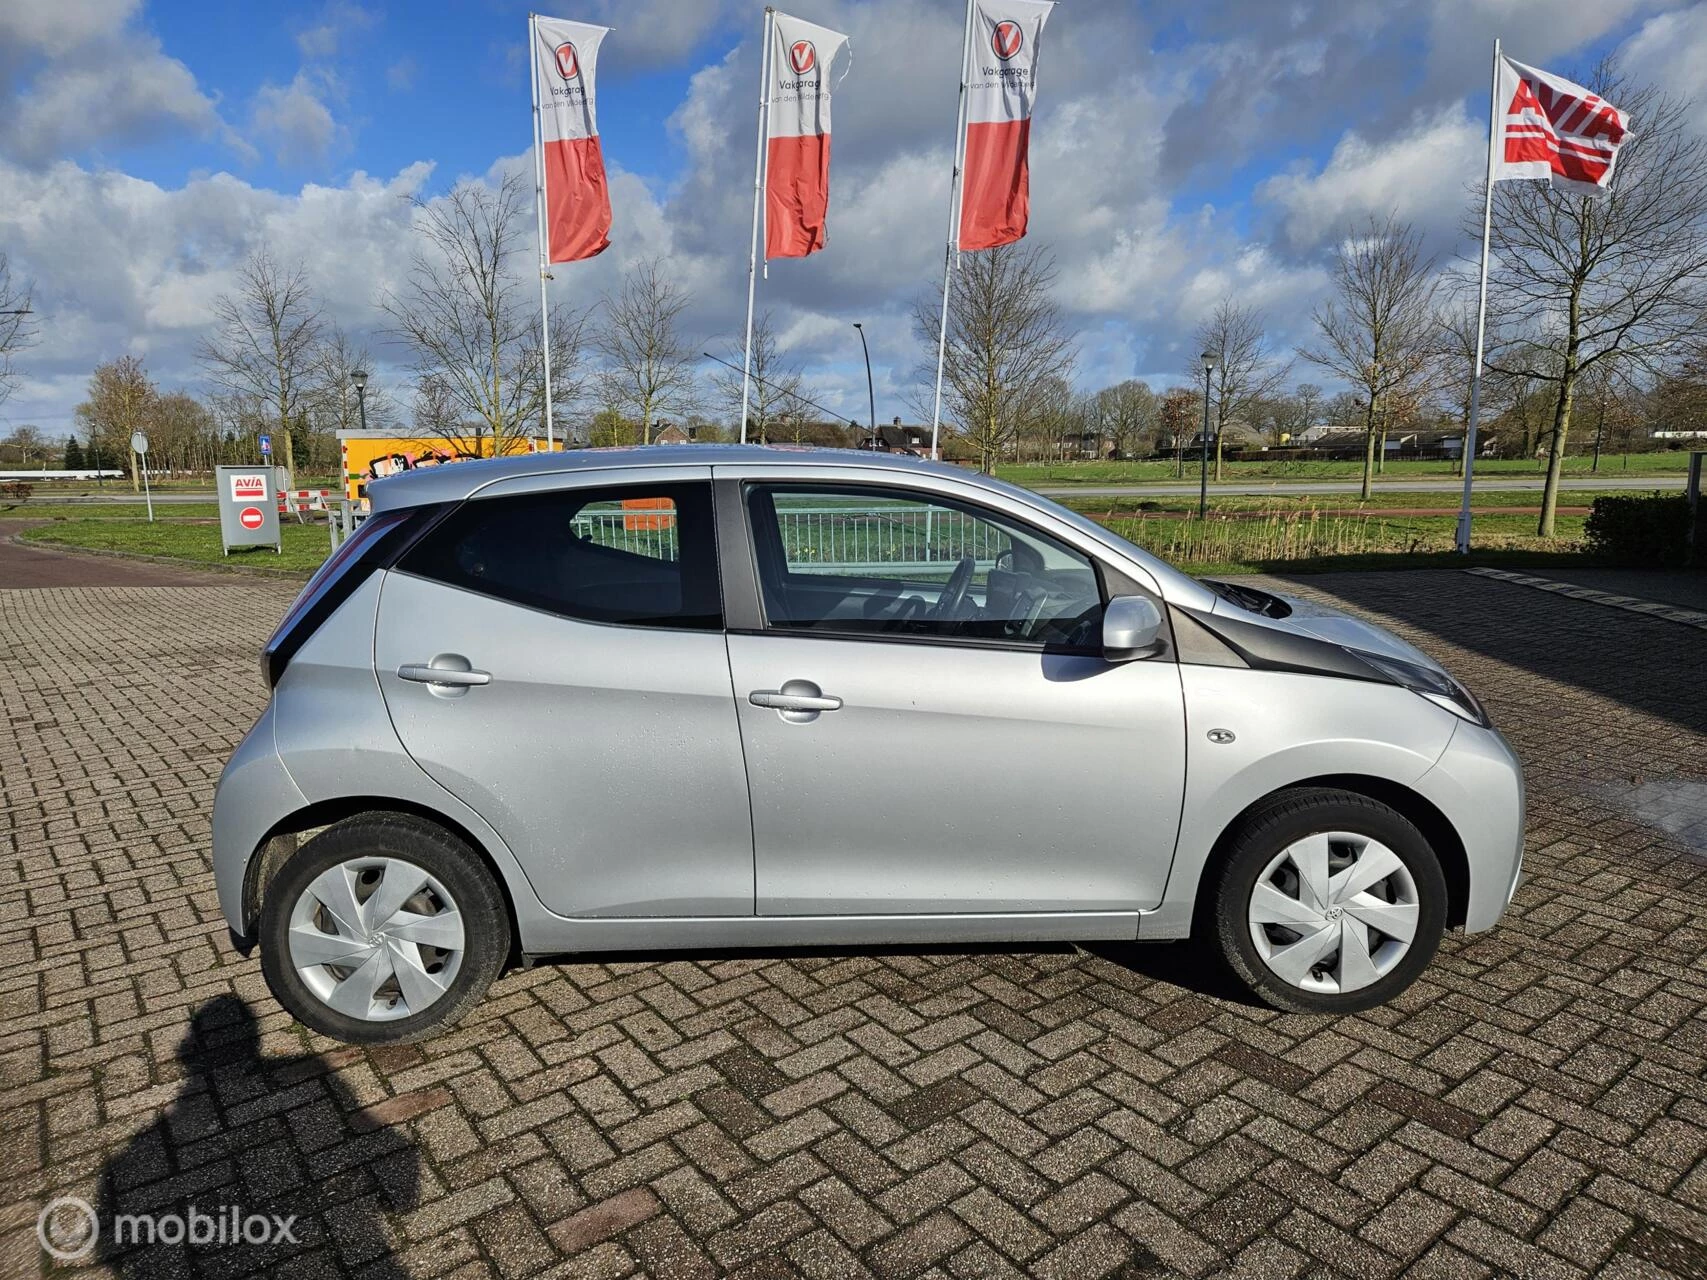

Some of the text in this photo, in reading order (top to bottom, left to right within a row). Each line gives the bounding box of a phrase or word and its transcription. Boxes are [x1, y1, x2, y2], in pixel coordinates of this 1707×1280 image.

[982, 66, 1029, 78] Vakgarage
[779, 80, 821, 91] Vakgarag
[1507, 78, 1625, 144] AVIA
[235, 476, 263, 487] AVIA
